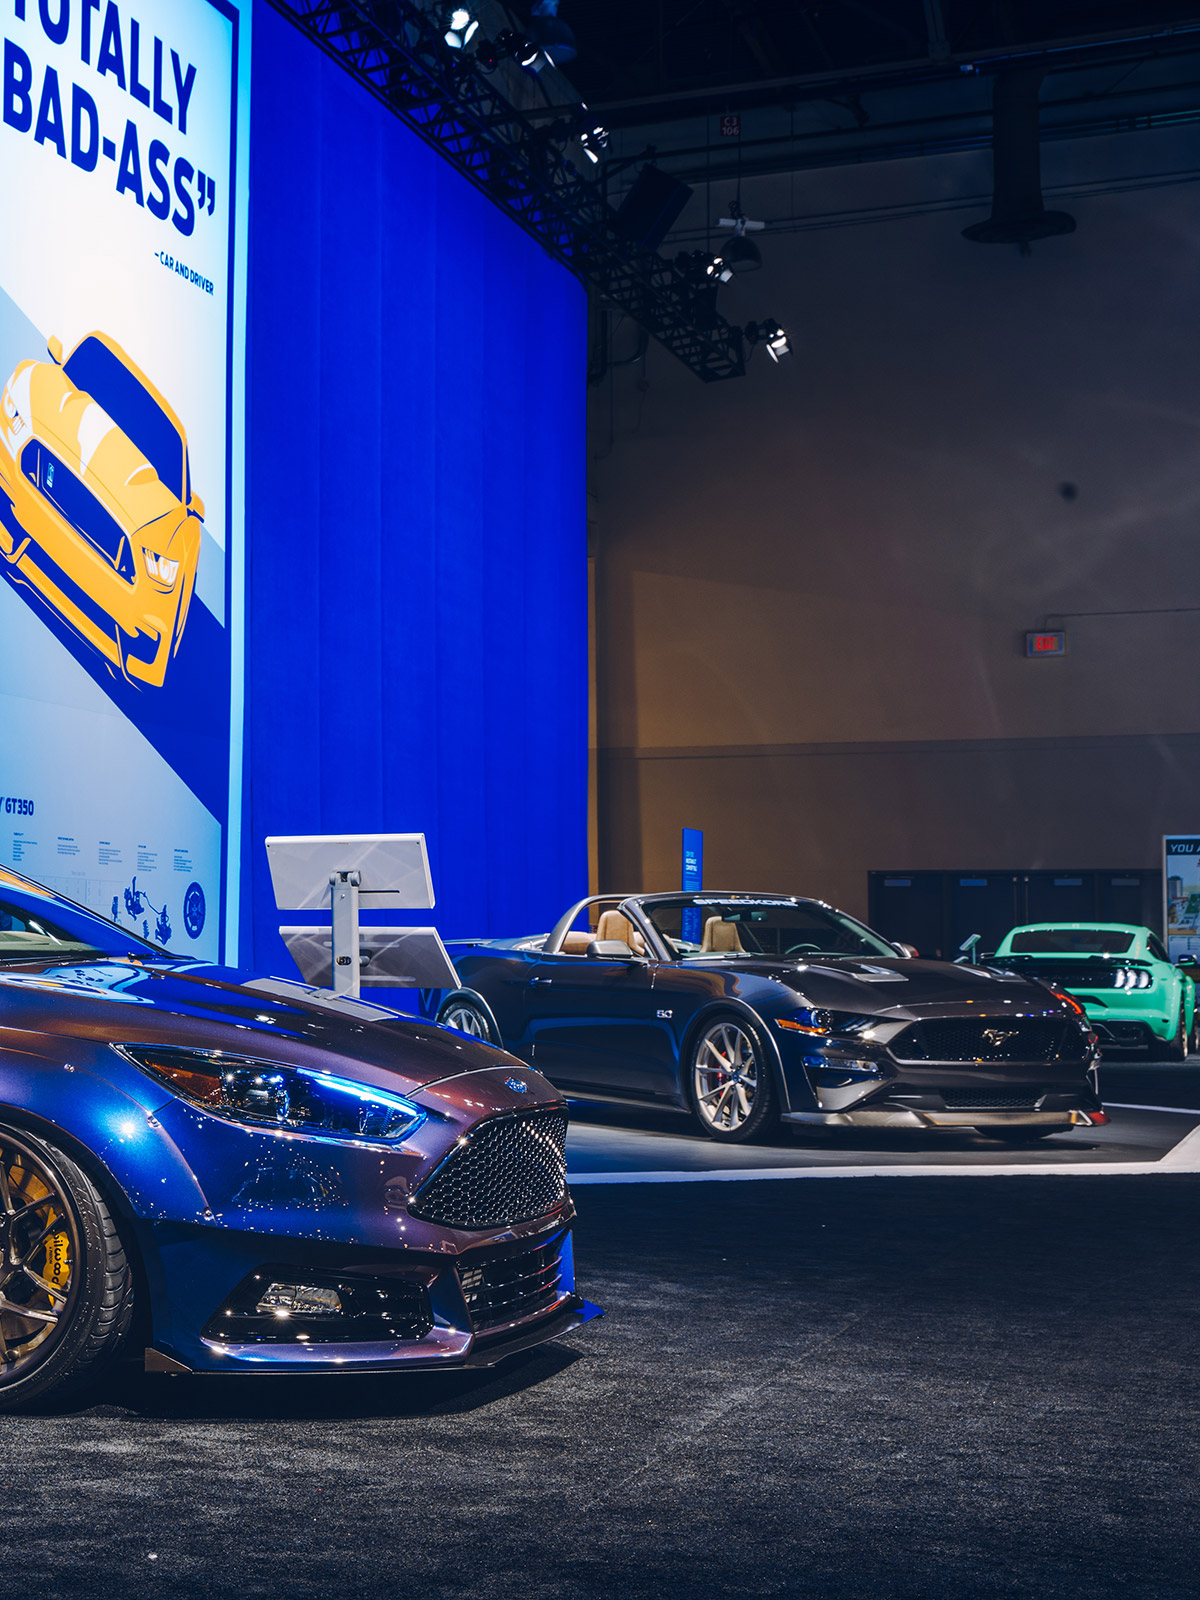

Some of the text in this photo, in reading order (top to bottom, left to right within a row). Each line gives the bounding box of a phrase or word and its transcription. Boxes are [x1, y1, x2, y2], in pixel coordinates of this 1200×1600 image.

[13, 0, 197, 136] OTALLY
[722, 127, 739, 136] 106
[175, 260, 189, 280] AND
[190, 268, 214, 296] DRIVER
[5, 797, 35, 816] GT350
[1171, 843, 1194, 853] YOU
